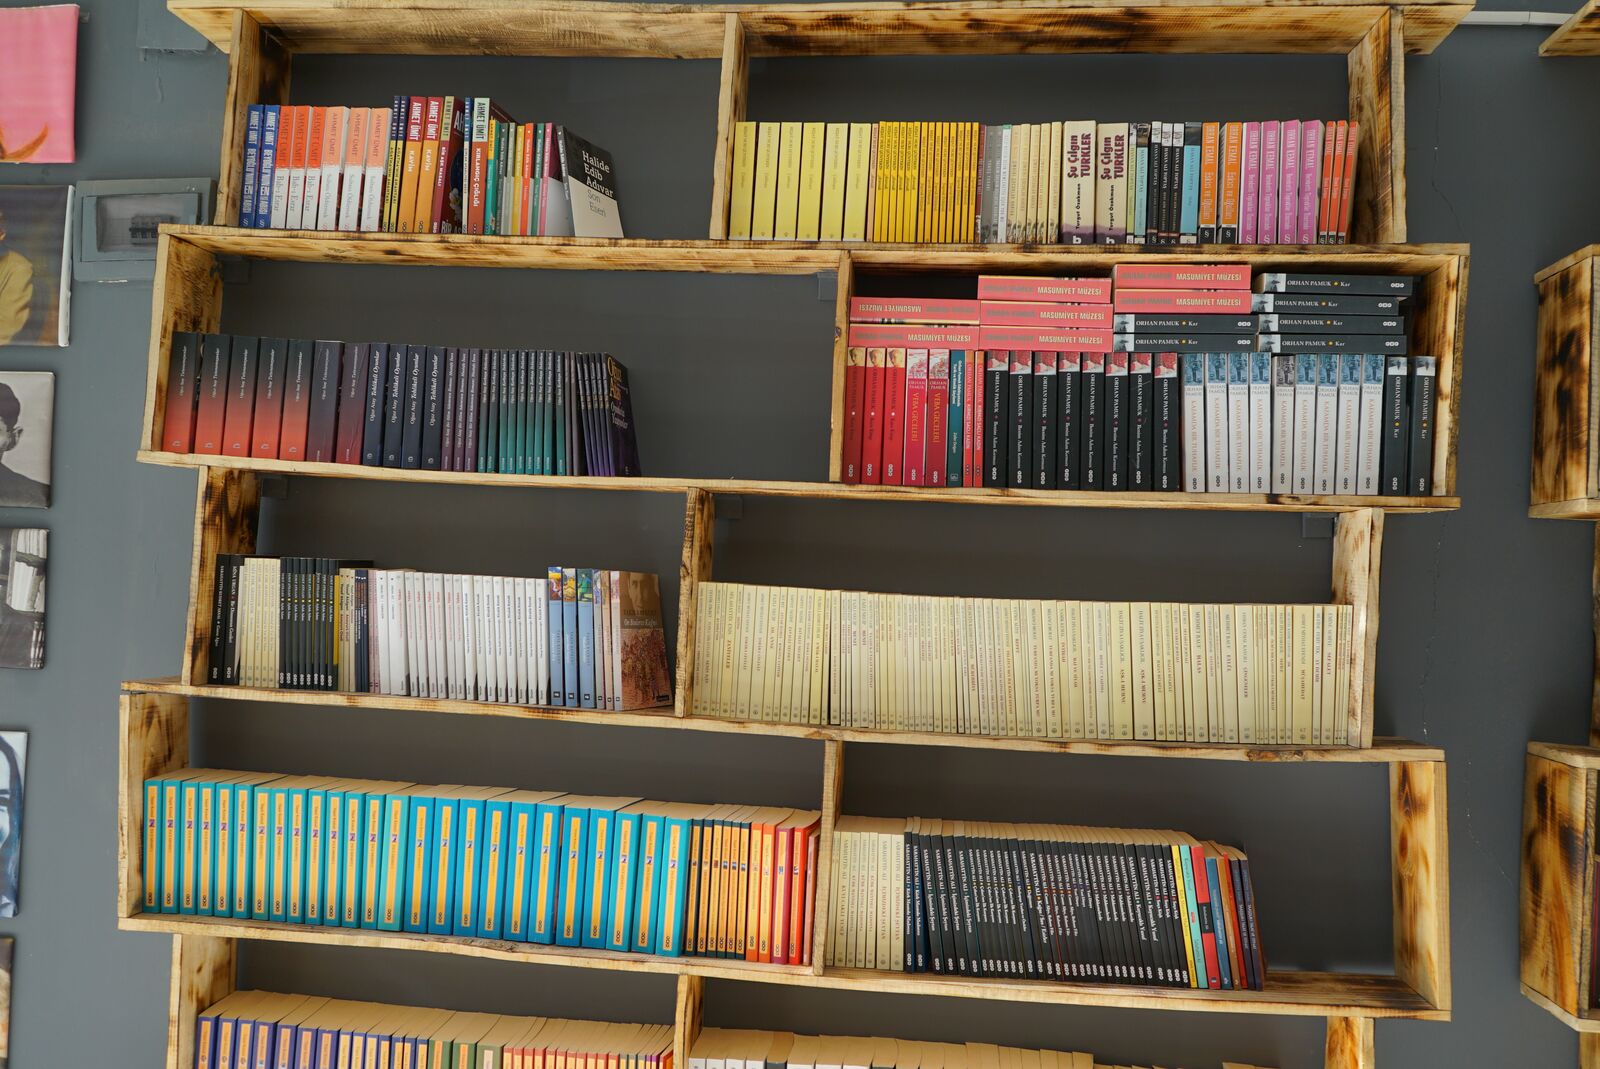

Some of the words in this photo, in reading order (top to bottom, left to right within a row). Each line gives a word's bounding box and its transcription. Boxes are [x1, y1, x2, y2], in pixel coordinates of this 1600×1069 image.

[412, 102, 421, 124] AHMET
[429, 100, 439, 122] AHMET
[477, 102, 486, 122] AHMET
[582, 150, 610, 174] Halide
[584, 163, 603, 181] Edib
[1068, 166, 1079, 178] Şu
[1101, 168, 1112, 180] Şu
